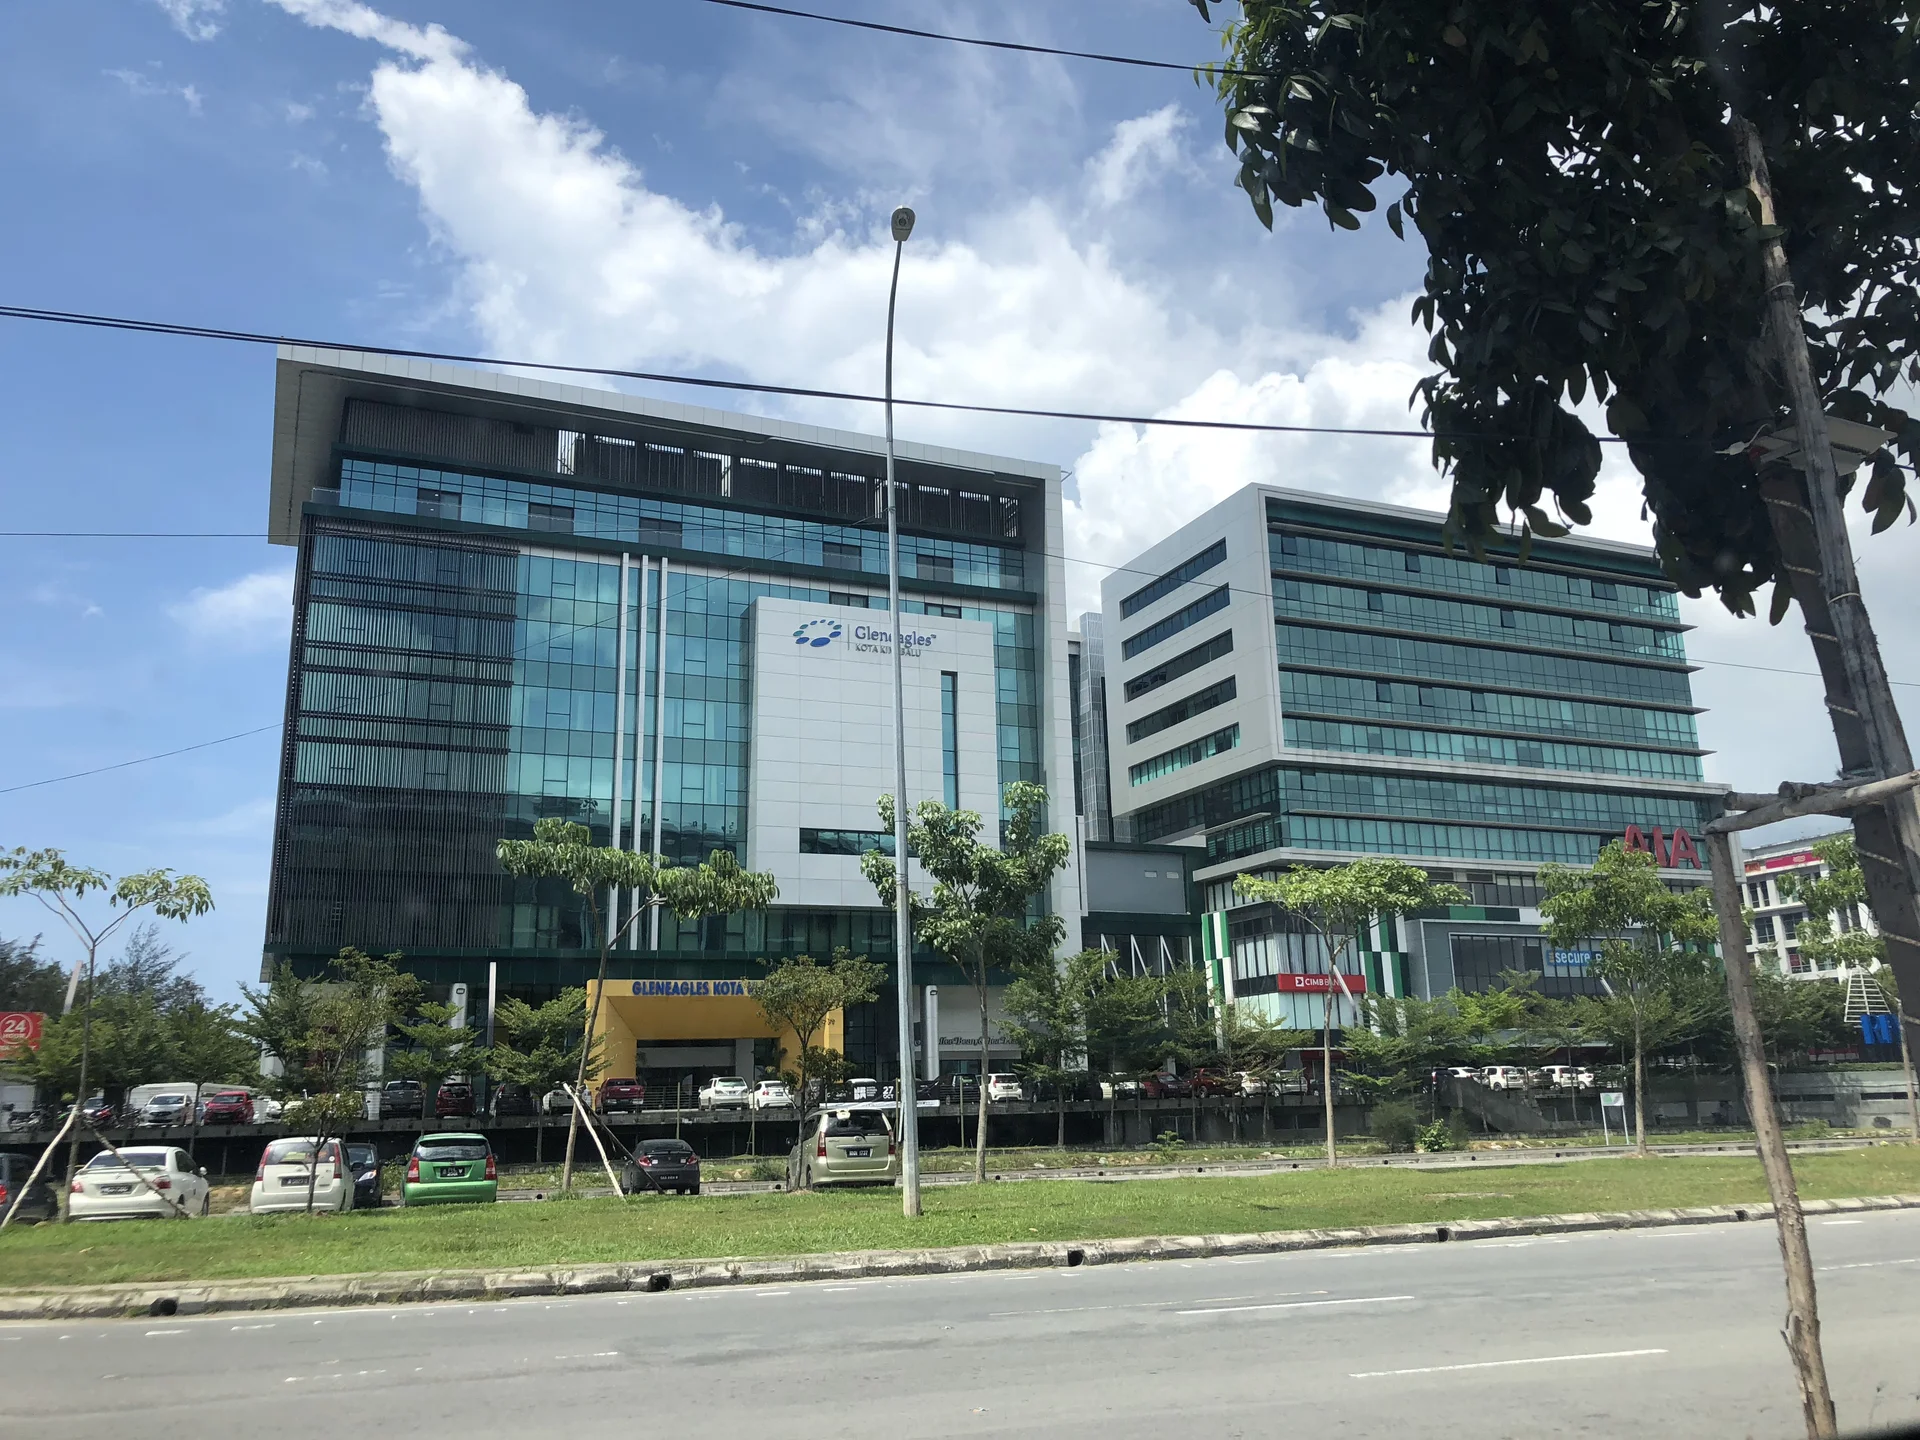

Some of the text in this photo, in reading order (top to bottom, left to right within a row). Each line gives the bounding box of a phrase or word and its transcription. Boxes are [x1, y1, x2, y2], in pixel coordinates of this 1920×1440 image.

[856, 644, 879, 653] KOTA
[1624, 824, 1703, 870] AIA
[1555, 952, 1590, 964] secure
[1305, 978, 1323, 986] CIMB
[632, 981, 710, 996] GLENEAGLES
[713, 981, 745, 996] KOTA
[4, 1020, 26, 1032] 24
[882, 1086, 894, 1094] 27
